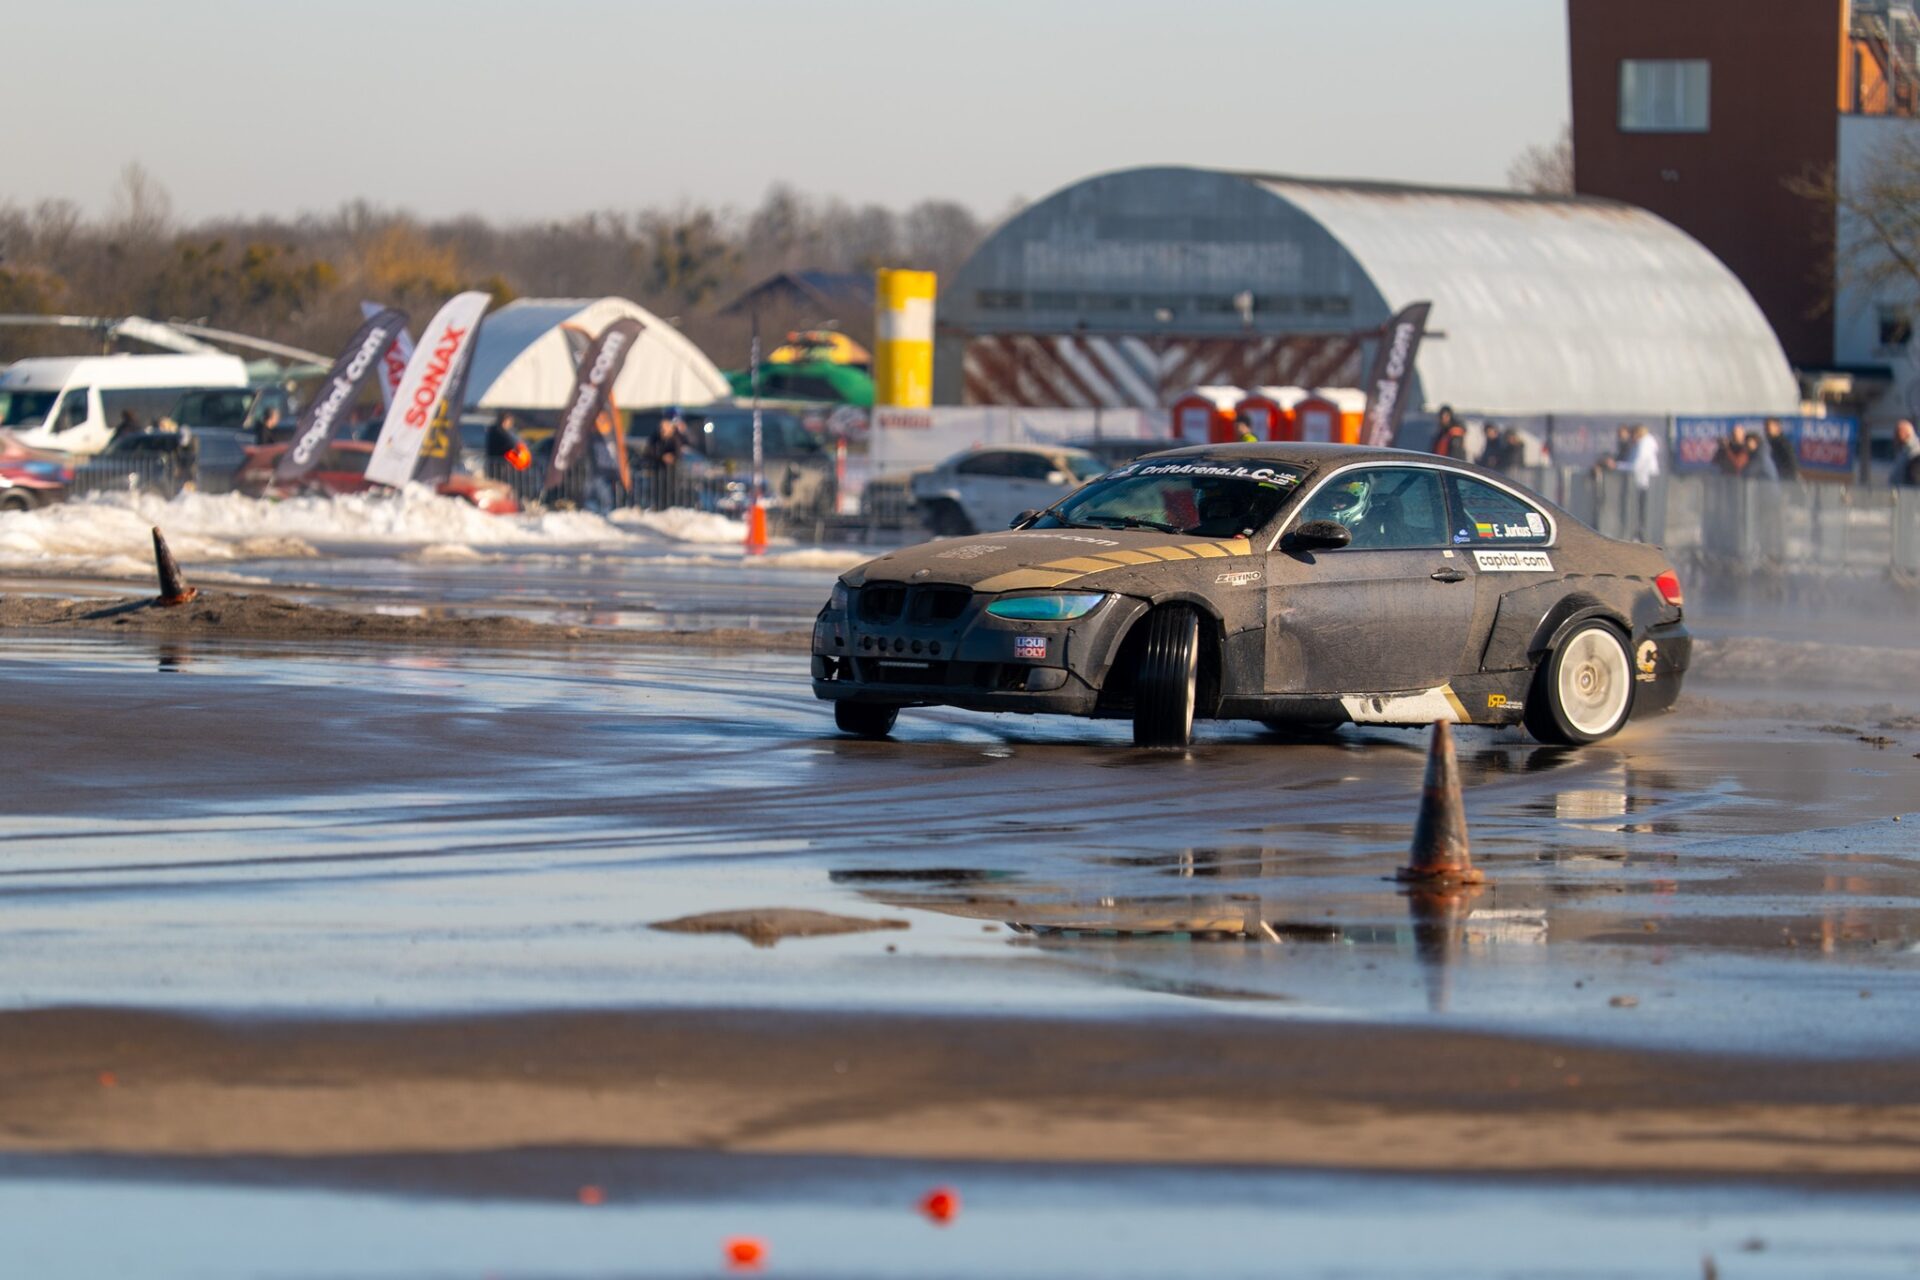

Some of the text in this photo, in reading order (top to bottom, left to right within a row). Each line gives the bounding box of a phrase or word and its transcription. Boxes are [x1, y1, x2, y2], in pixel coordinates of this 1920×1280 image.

[293, 327, 387, 465] capital.com
[404, 324, 466, 429] SONAX
[553, 331, 626, 471] capital.com
[1479, 552, 1549, 569] capital.com
[1016, 647, 1044, 657] MOLY
[1017, 637, 1044, 647] LIQUI
